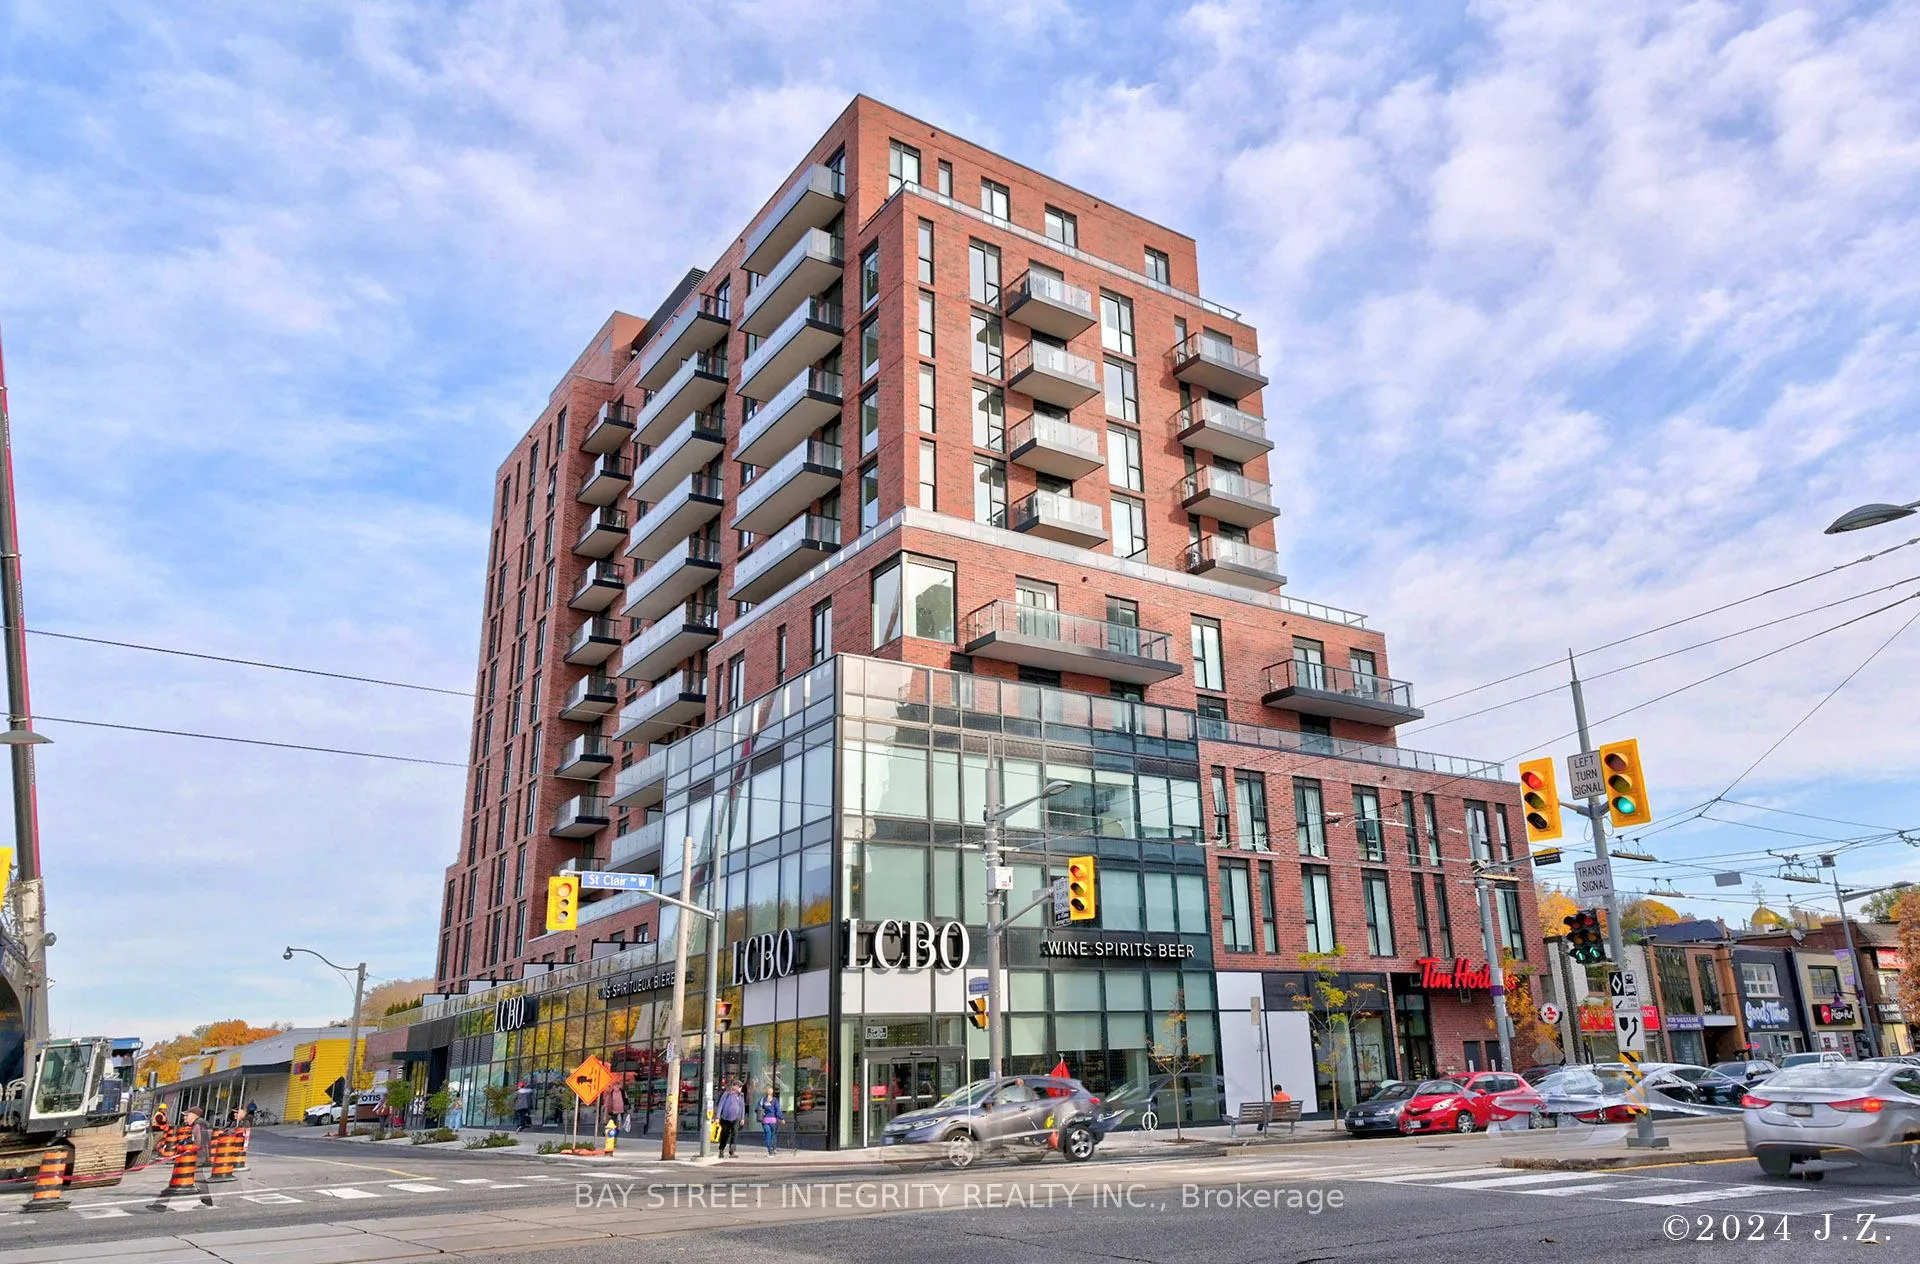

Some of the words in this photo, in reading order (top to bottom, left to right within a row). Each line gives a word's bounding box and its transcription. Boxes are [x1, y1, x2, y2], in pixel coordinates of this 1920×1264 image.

[1574, 755, 1594, 768] LEFT
[1575, 769, 1598, 781] TURN
[1574, 783, 1603, 797] SIGNAL
[1577, 863, 1609, 878] TRANSIT
[588, 874, 599, 885] St
[603, 875, 627, 886] Clair
[638, 877, 648, 887] W
[1581, 880, 1609, 893] SIGNAL
[846, 918, 970, 970] LCBO
[1048, 941, 1088, 956] WINE
[1095, 941, 1152, 957] SPIRITS
[1158, 943, 1195, 958] BEER
[732, 928, 794, 986] LCBO
[1416, 957, 1452, 989] Tim
[494, 995, 525, 1032] LCBO
[1744, 1000, 1767, 1028] Good
[1766, 1000, 1790, 1023] Times
[361, 1094, 381, 1102] OTIS
